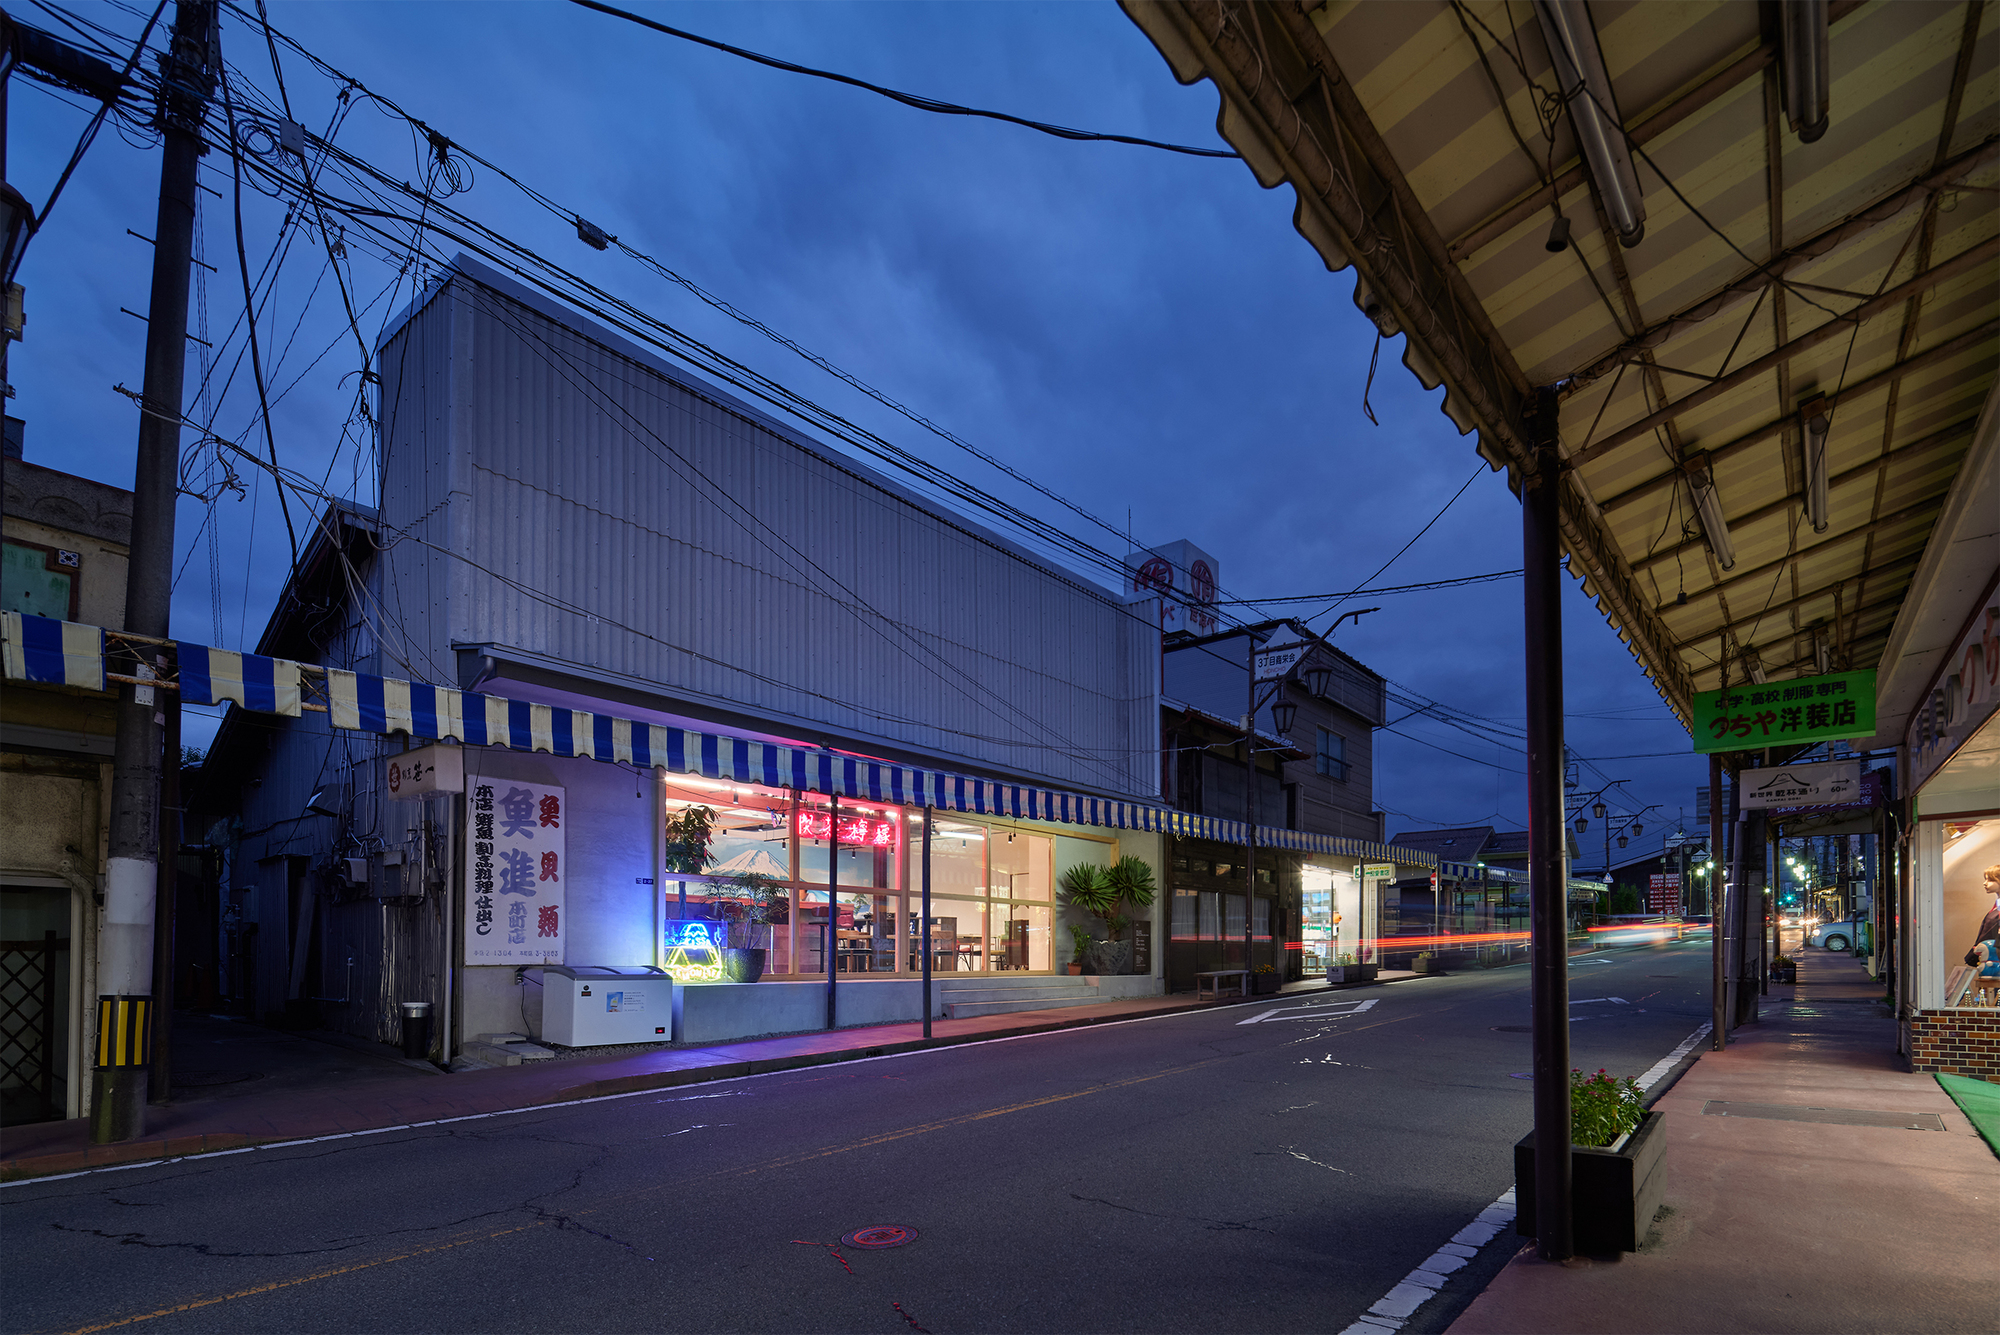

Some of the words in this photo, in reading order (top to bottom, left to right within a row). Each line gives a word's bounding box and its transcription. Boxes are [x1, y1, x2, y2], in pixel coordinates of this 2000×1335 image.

[1257, 653, 1296, 668] 3丁目商栄会
[1263, 666, 1286, 674] HONCHO
[1708, 699, 1857, 740] つちや洋装店
[507, 900, 528, 945] 本町店
